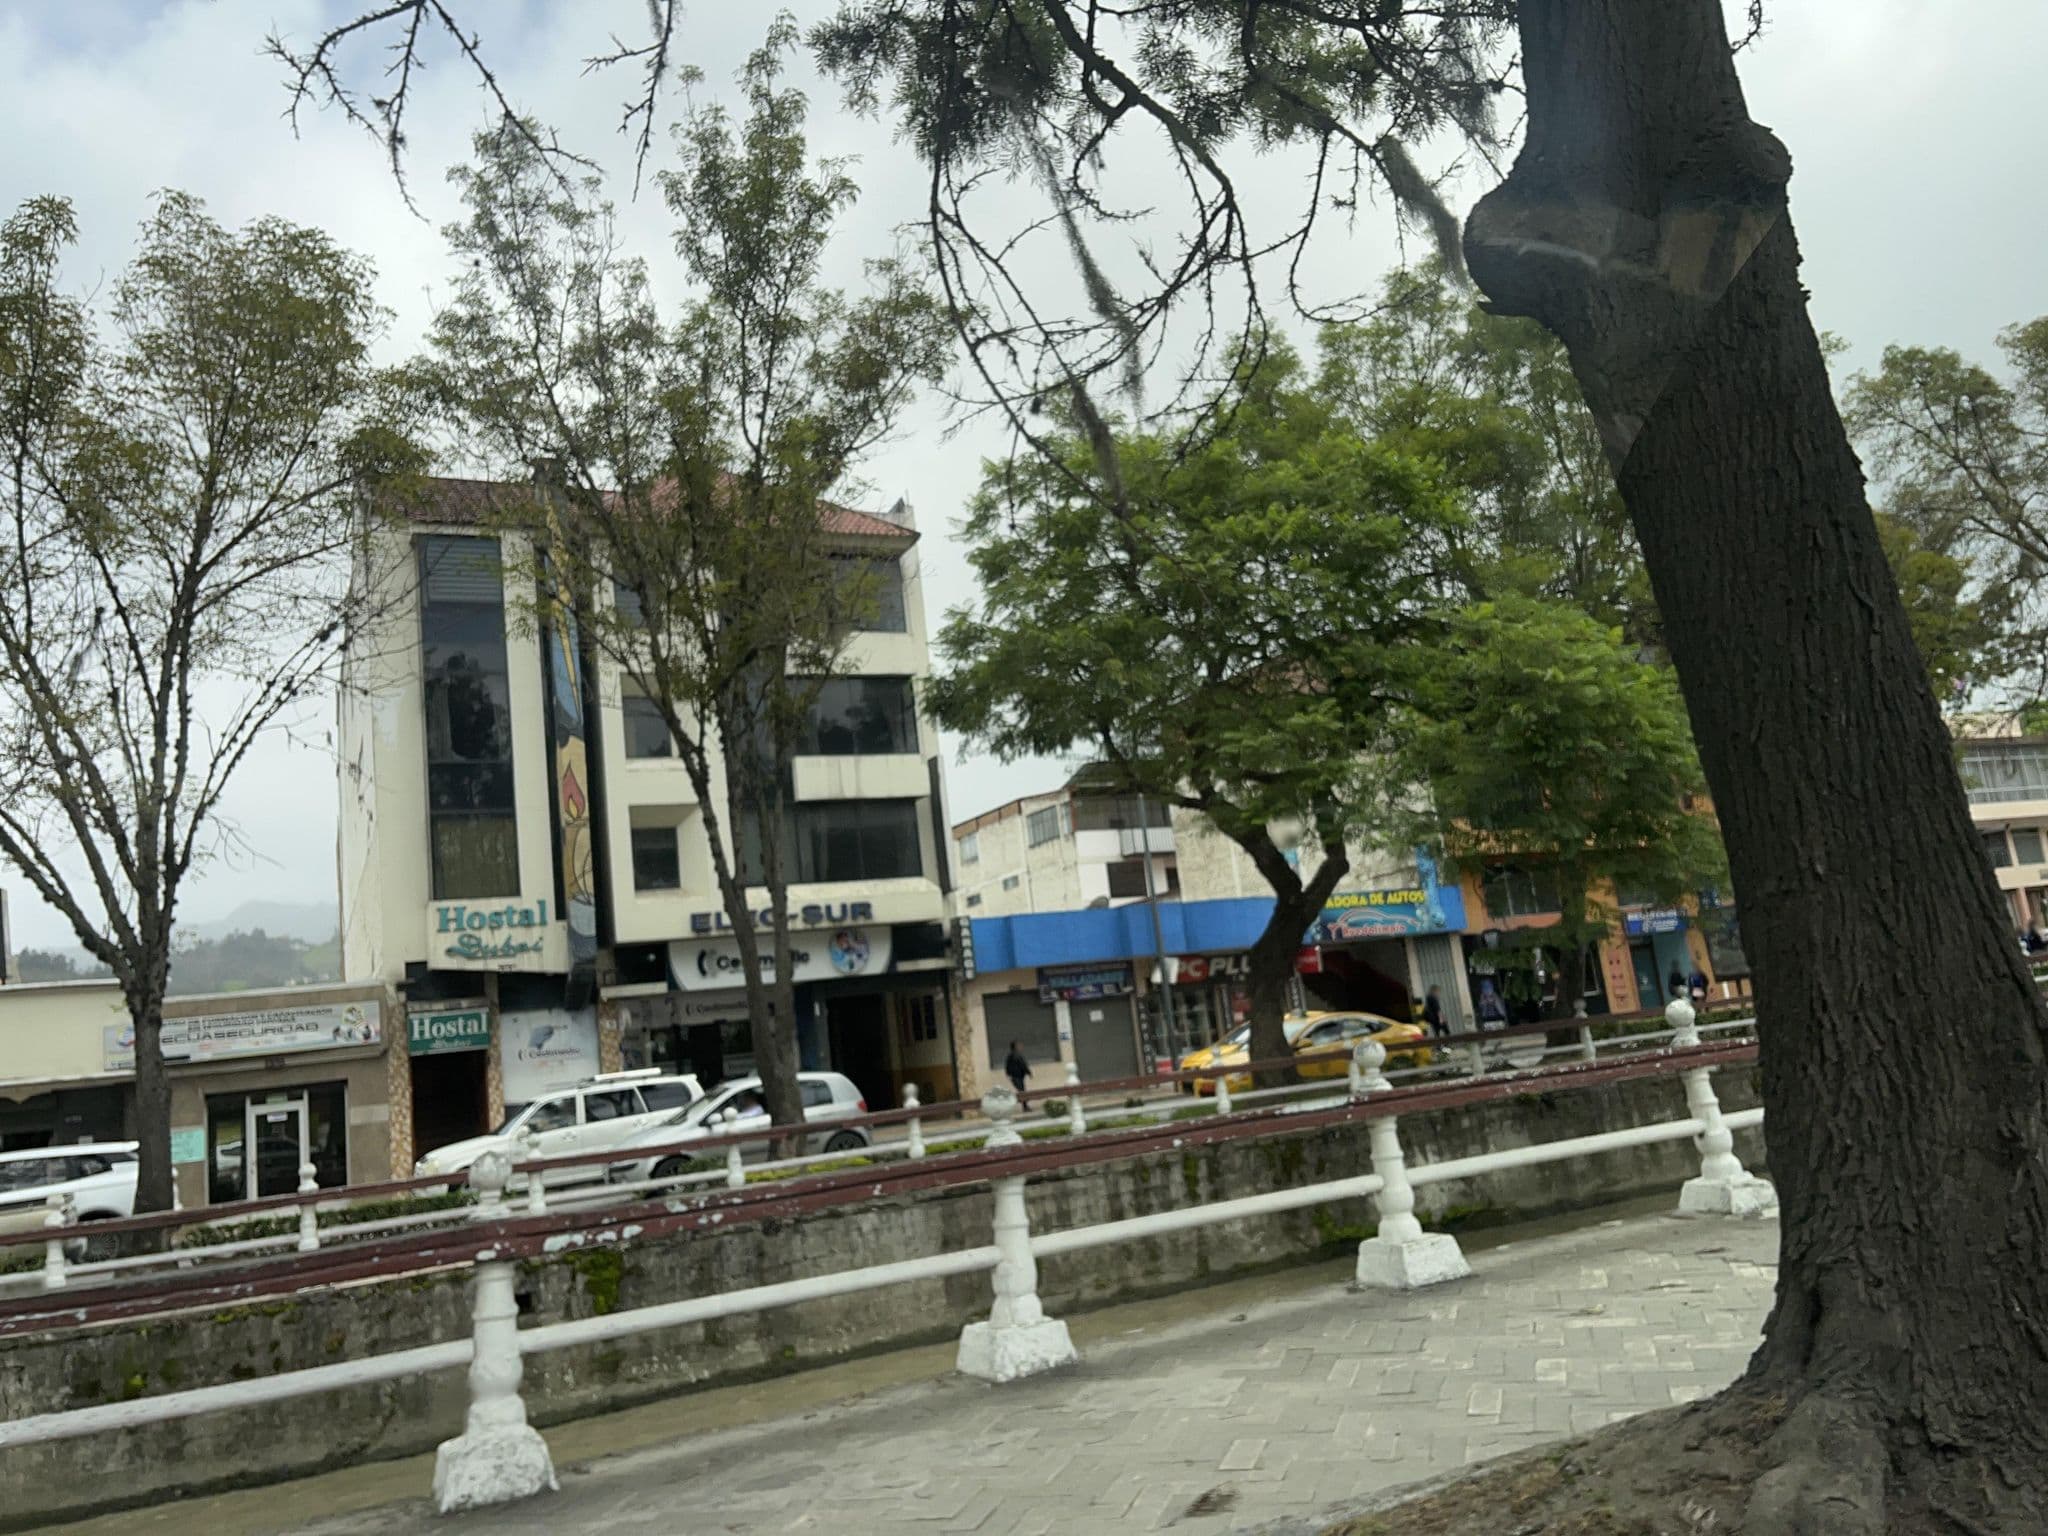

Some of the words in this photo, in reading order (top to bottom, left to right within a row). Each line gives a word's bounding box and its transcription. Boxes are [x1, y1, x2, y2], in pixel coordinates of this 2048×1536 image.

[1370, 892, 1384, 904] DE
[1387, 889, 1425, 905] AUTOS
[436, 899, 548, 933] Hostal
[411, 1012, 489, 1041] Hostal
